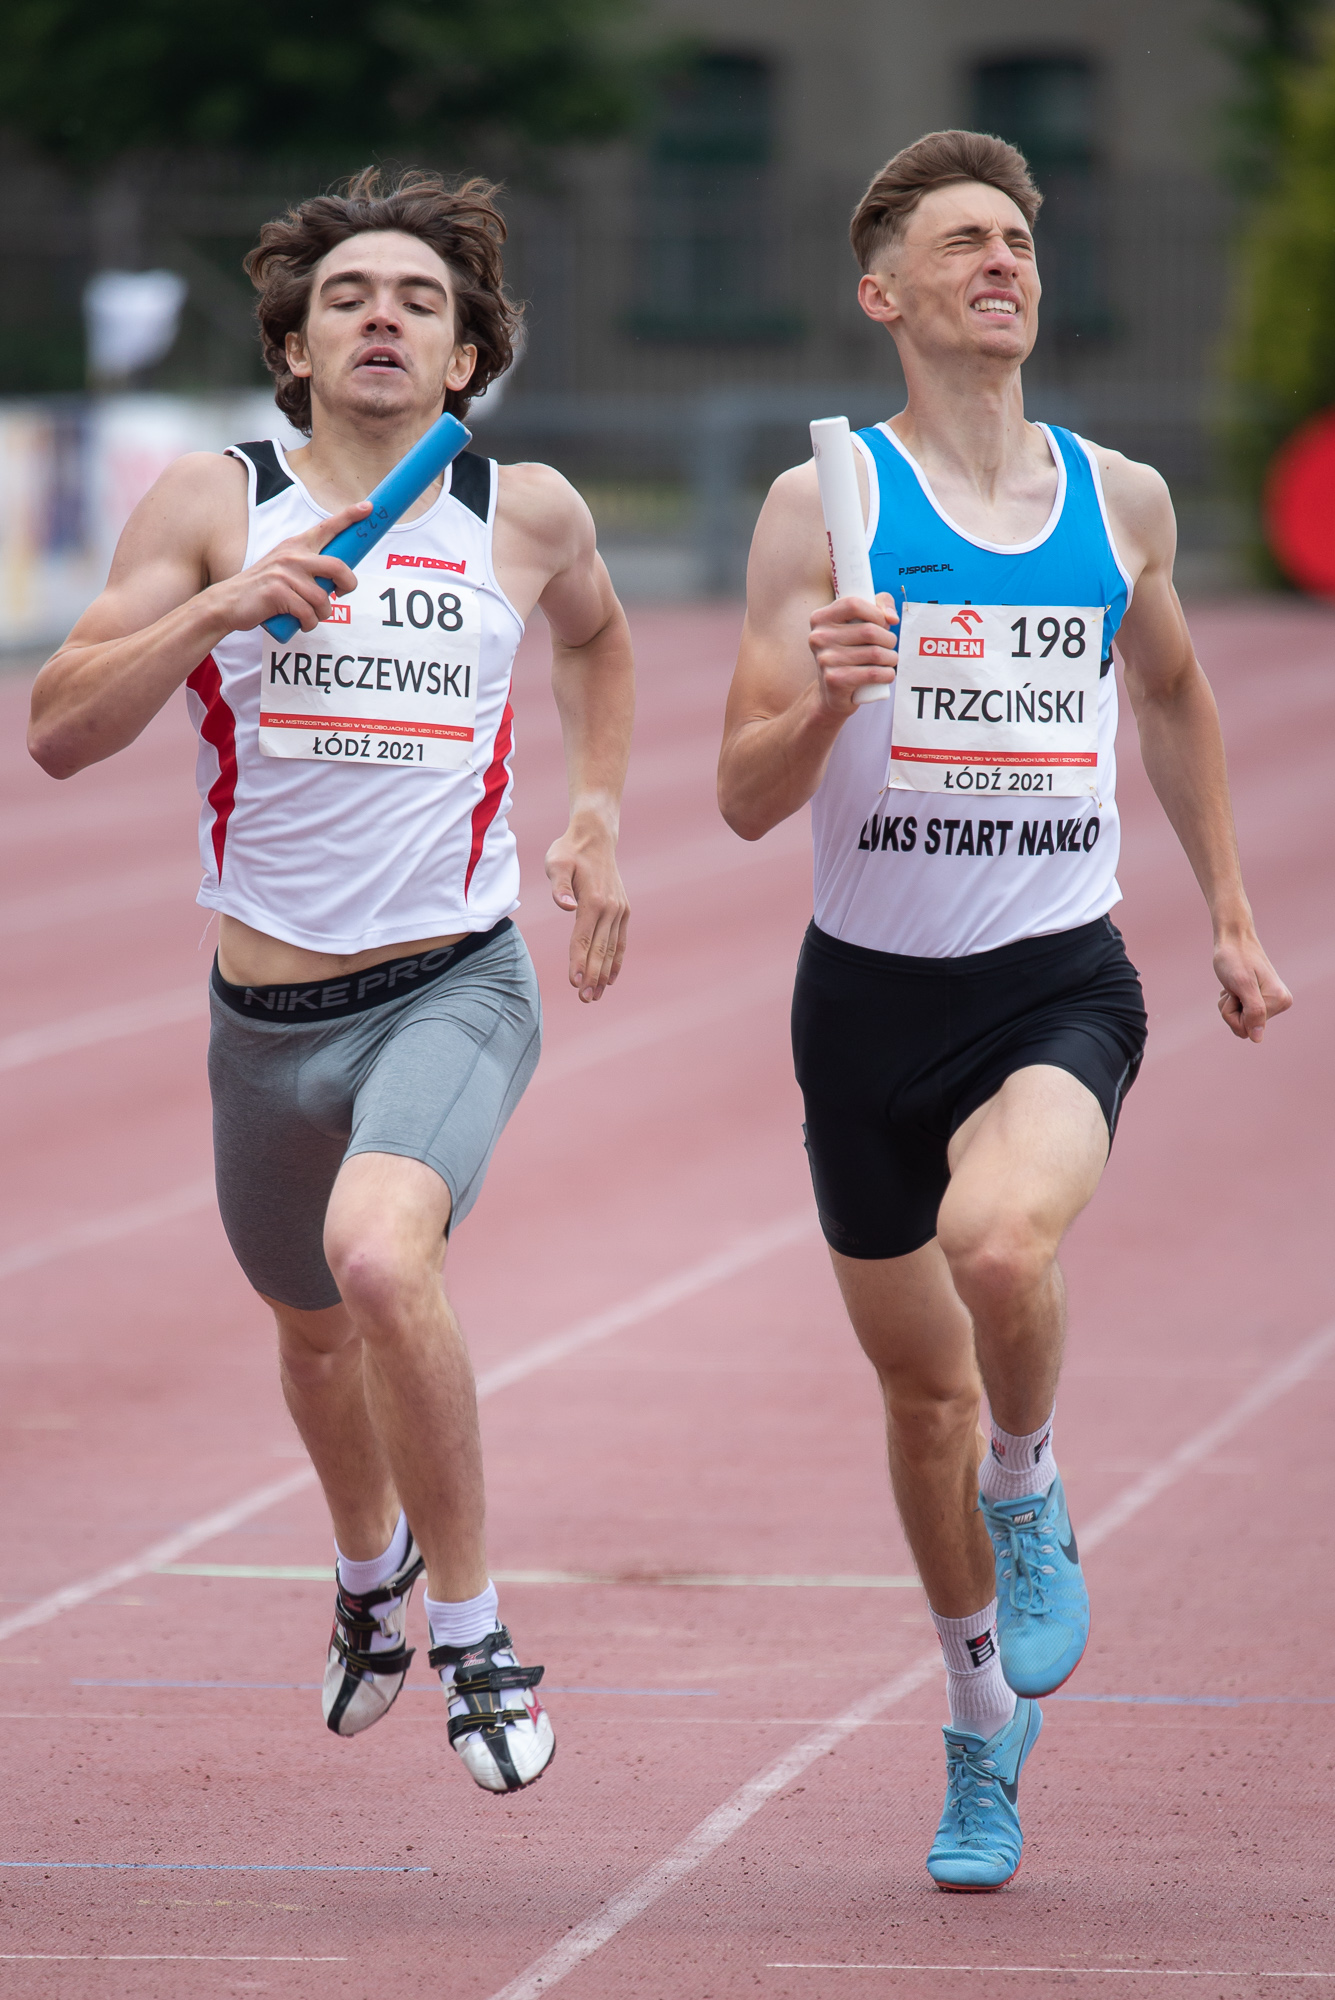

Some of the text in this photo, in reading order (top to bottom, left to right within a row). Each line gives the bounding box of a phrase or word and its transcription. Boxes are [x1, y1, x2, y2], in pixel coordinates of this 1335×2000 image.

[898, 563, 954, 576] PJSPORT.PL
[379, 587, 464, 632] 108
[922, 639, 981, 656] ORLEN
[1010, 616, 1086, 659] 198
[269, 651, 471, 698] KRĘCZEWSKI
[911, 682, 1085, 723] TRZCIŃSKI
[313, 732, 424, 761] ŁÓDŹ 2021
[944, 766, 1053, 791] ŁÓDŹ 2021
[858, 813, 918, 852] LUKS
[924, 818, 1014, 856] START
[243, 946, 455, 1011] NIKE PRO
[1013, 1511, 1034, 1524] NIKE
